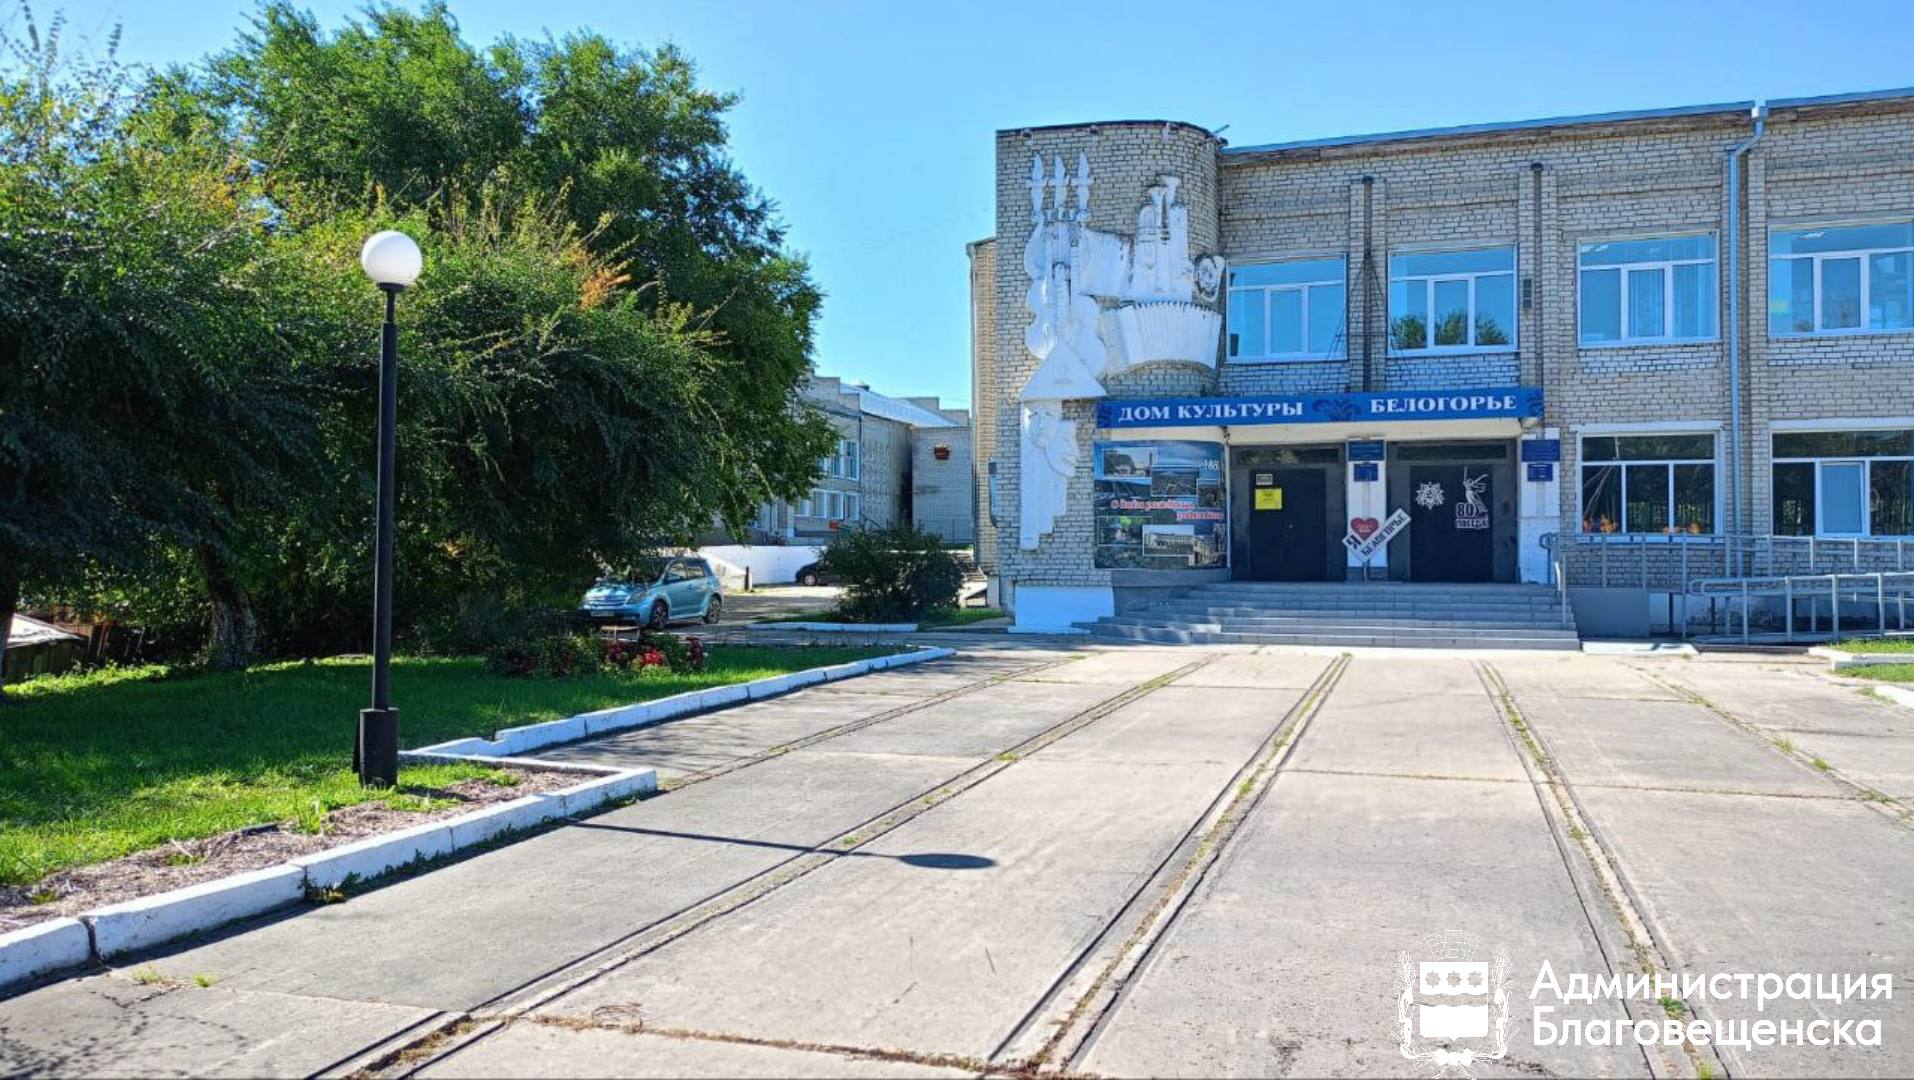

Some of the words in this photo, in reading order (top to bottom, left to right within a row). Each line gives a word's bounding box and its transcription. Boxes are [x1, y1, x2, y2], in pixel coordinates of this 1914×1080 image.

[1118, 406, 1169, 422] ДОМ
[1178, 401, 1304, 420] КУЛЬТУРЫ
[1370, 395, 1517, 413] БЕЛОГОРЬЕ
[1456, 502, 1476, 518] 80
[1346, 533, 1361, 550] Я
